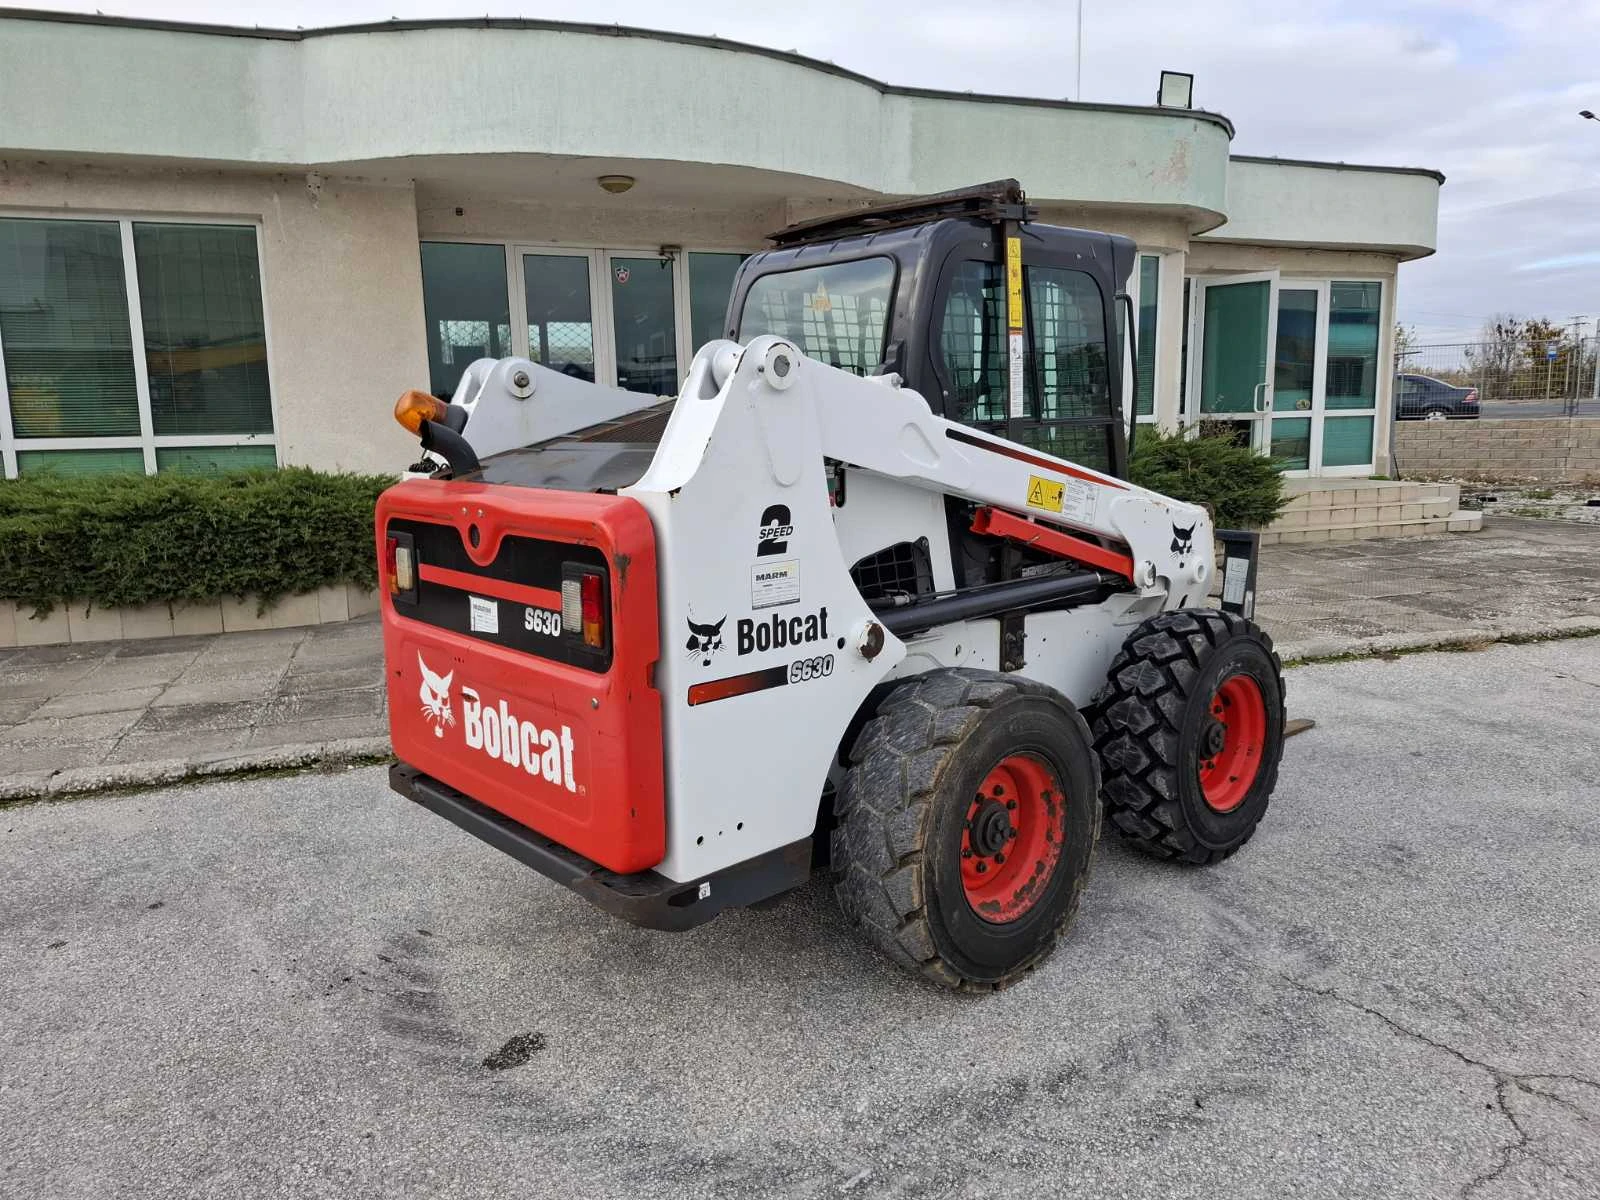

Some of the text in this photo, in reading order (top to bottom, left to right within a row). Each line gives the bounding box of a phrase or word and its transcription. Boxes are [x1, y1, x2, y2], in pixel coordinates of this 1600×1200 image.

[759, 525, 794, 540] SPEED
[755, 571, 788, 581] MARM
[524, 607, 561, 637] S630
[737, 607, 828, 656] Bobcat
[790, 653, 835, 684] S630
[461, 686, 576, 793] Bobcat
